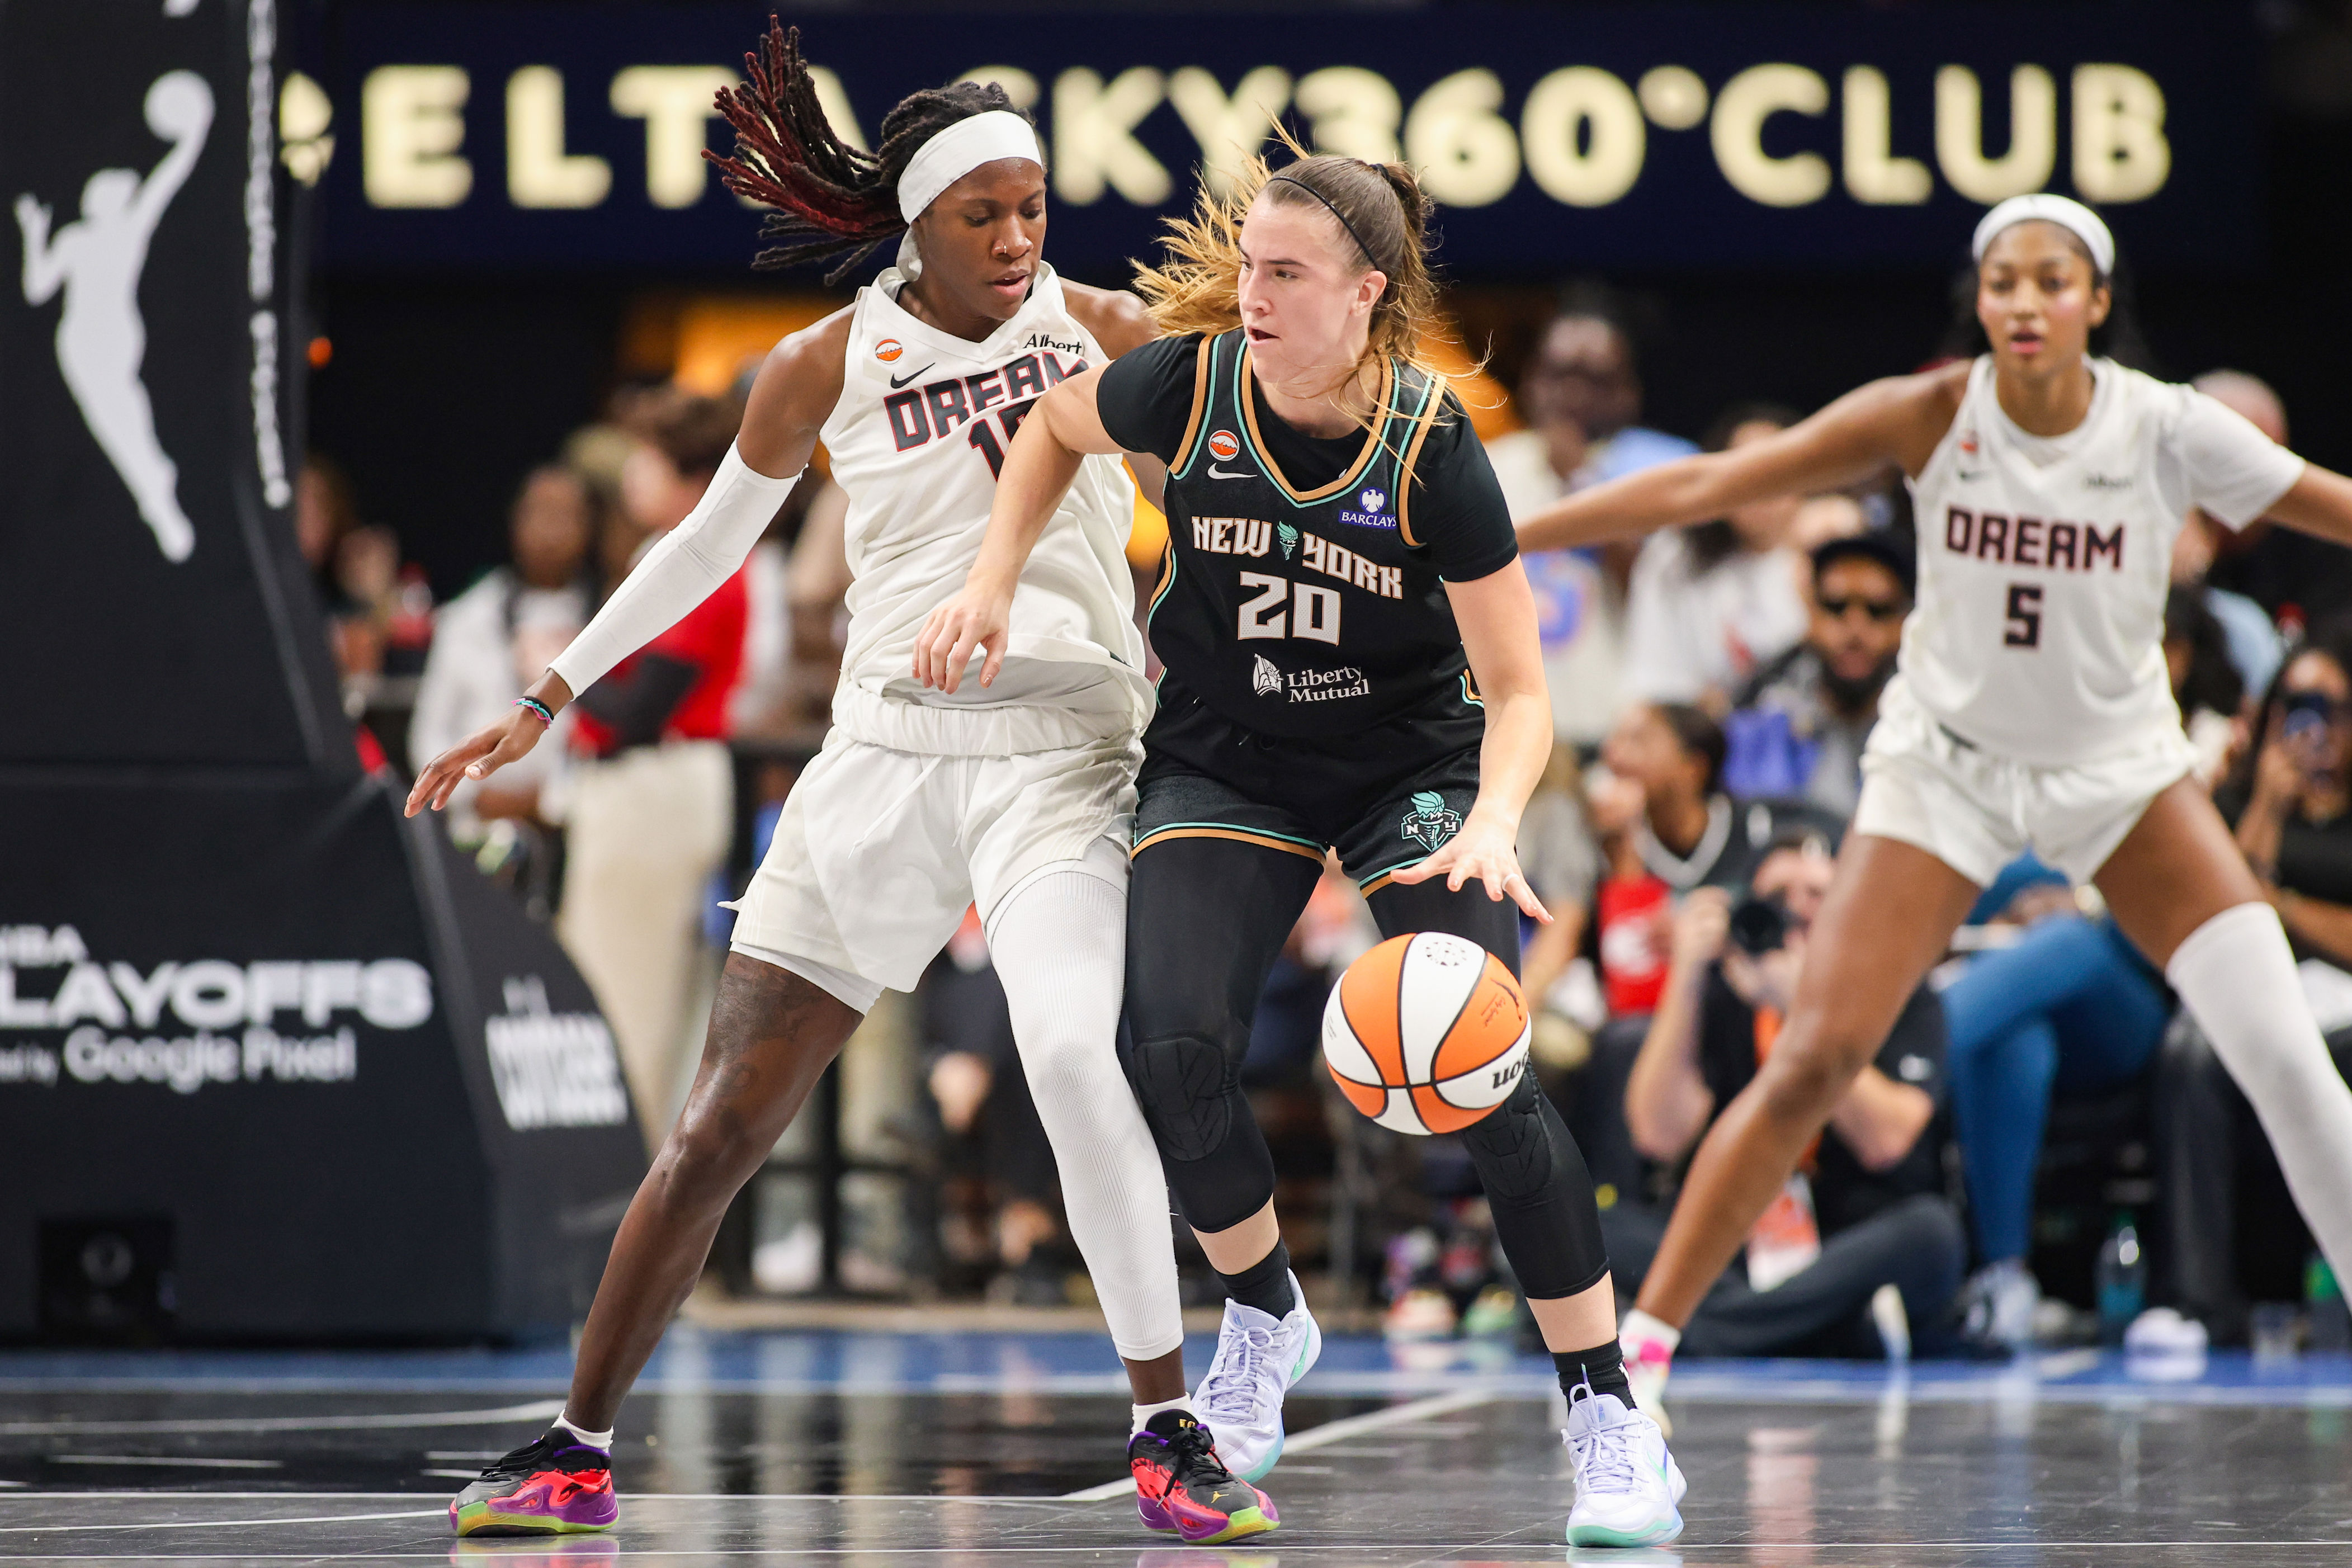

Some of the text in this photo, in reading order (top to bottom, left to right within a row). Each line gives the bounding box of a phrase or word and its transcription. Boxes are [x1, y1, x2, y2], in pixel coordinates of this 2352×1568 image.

[1022, 333, 1082, 354] Albert
[1341, 511, 1397, 527] BARCLAYS
[1945, 504, 2127, 573] DREAM
[1192, 516, 1402, 599] NEW YORK
[1238, 571, 1341, 646] 20
[2004, 584, 2044, 648] 5
[1287, 666, 1361, 687] Liberty
[1288, 678, 1371, 703] Mutual
[64, 1024, 239, 1094] Google
[243, 1026, 357, 1081] Pixel
